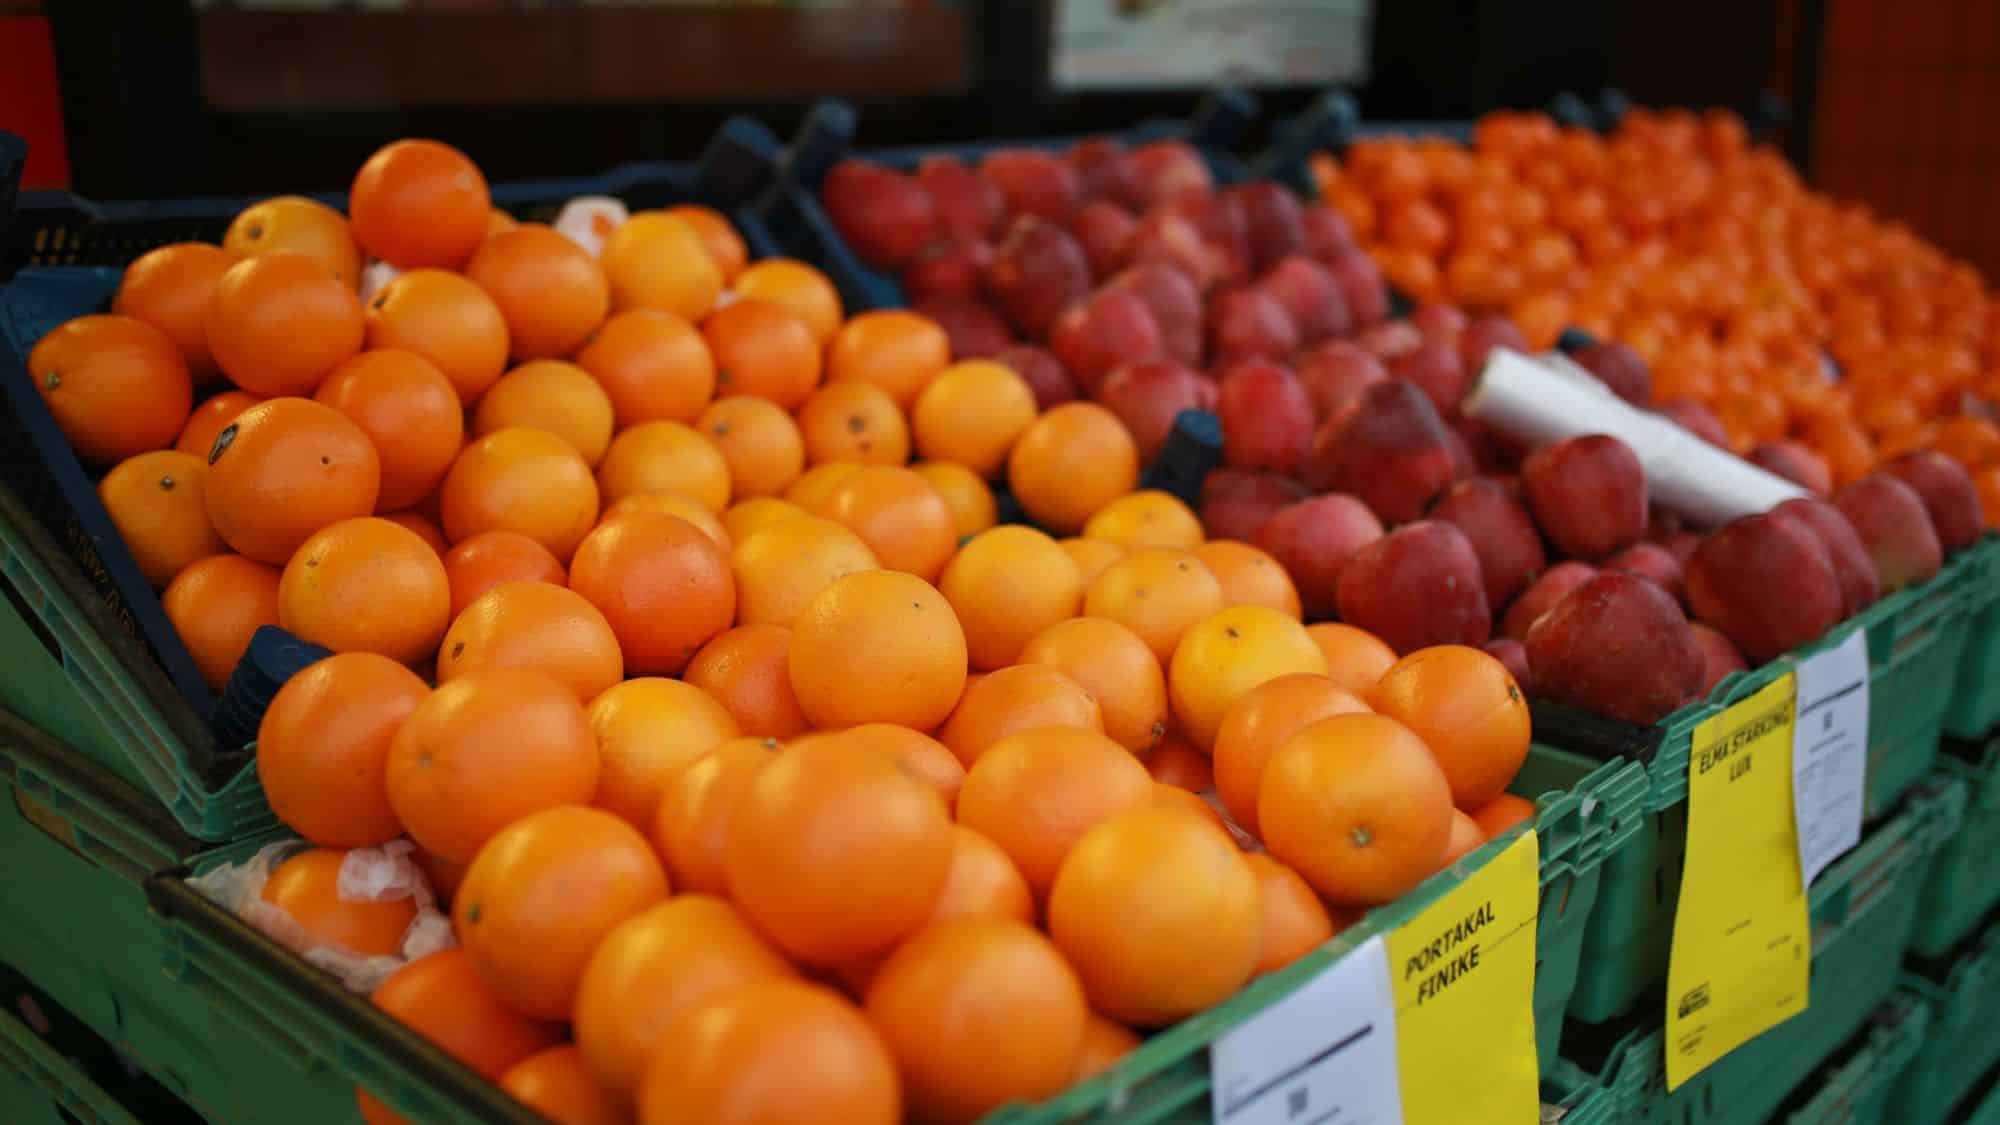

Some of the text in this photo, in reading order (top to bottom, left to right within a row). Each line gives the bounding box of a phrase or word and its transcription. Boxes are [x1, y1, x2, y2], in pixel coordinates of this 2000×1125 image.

[1699, 709, 1790, 775] ELMA STARKING
[1405, 901, 1495, 982] PORTAKAL
[1417, 944, 1480, 1006] FINIKE
